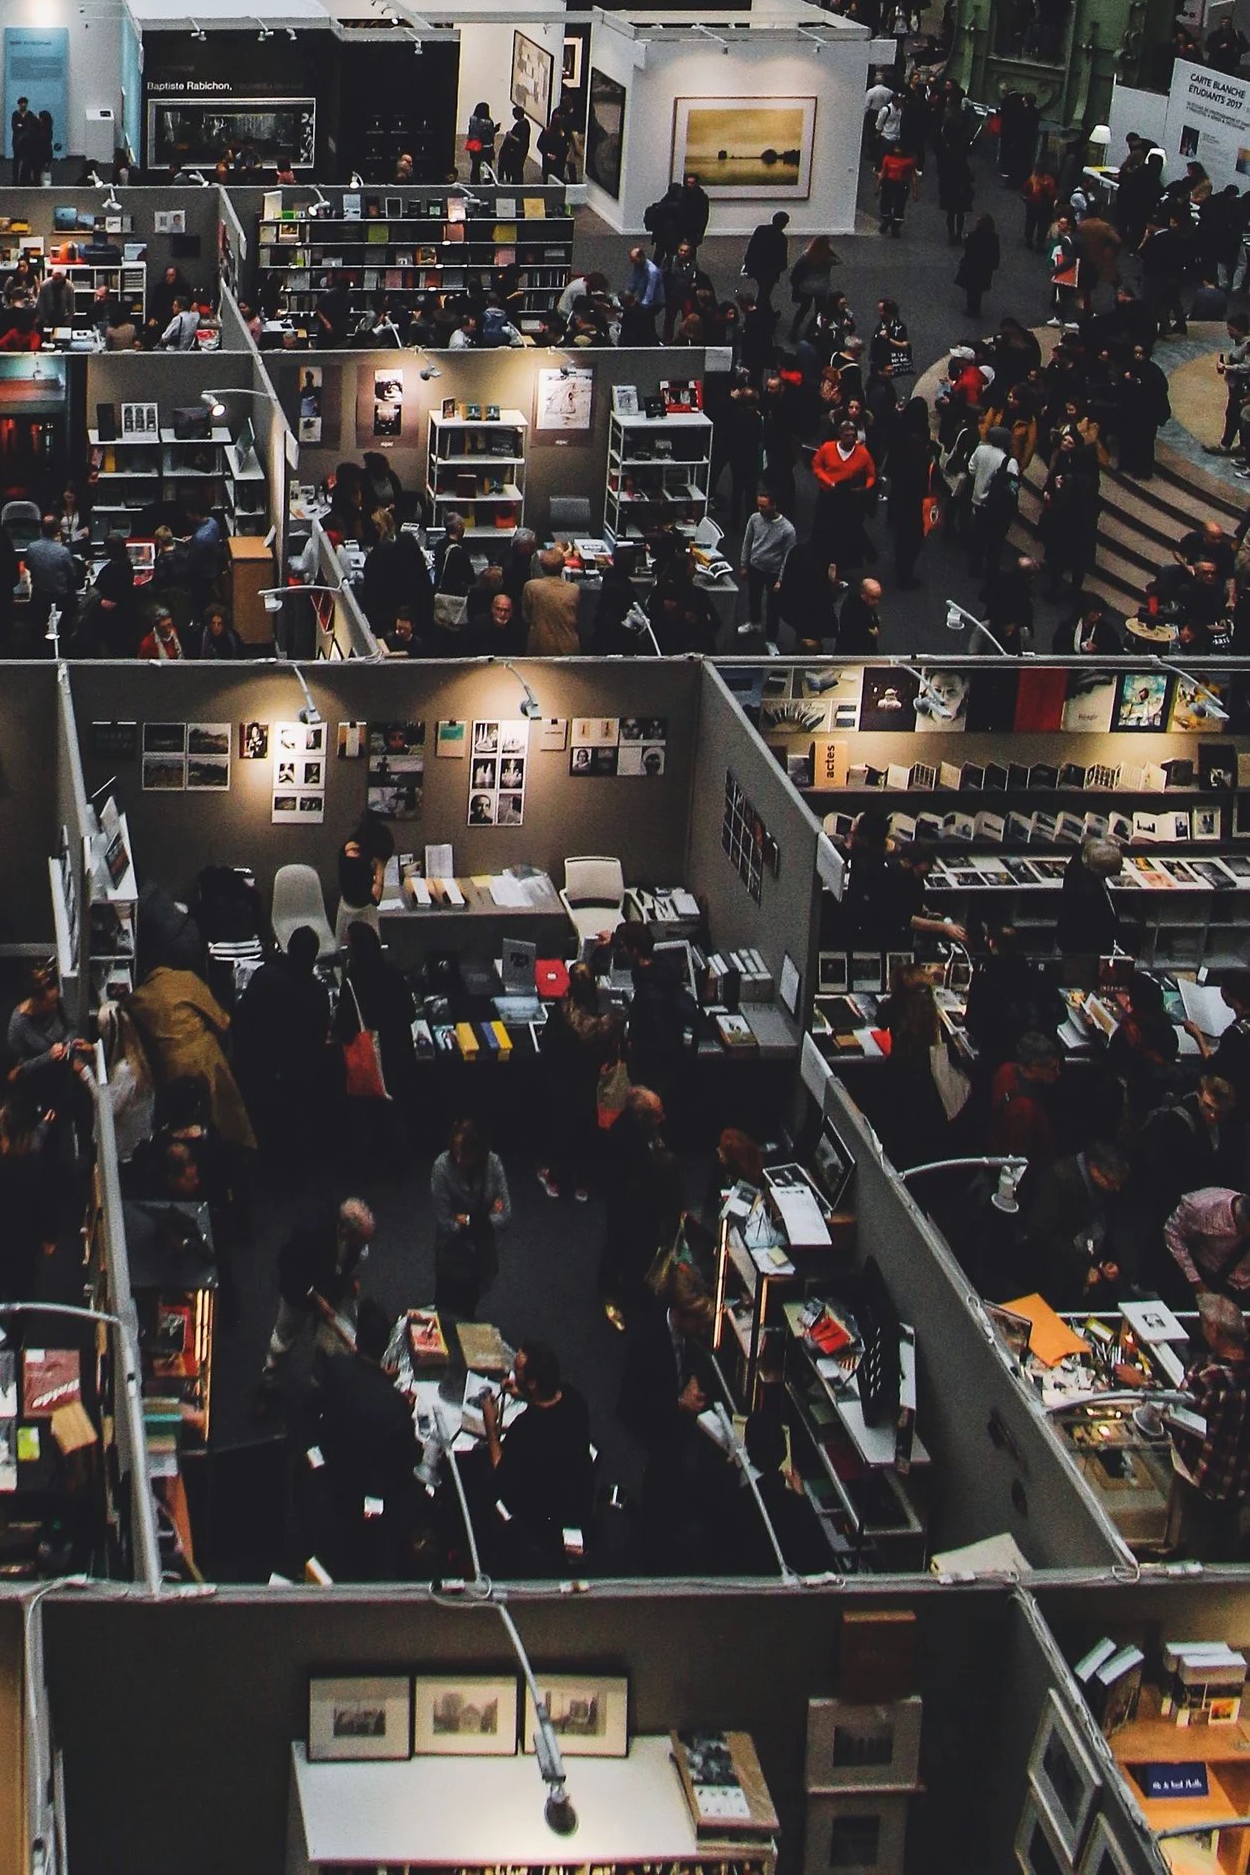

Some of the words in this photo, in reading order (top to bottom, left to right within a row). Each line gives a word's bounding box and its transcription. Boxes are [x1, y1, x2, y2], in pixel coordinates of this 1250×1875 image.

[147, 81, 185, 93] Baptiste
[186, 81, 233, 92] Rabichon,
[1190, 73, 1213, 88] CARTE
[1213, 81, 1247, 100] BLANCHE
[1226, 98, 1244, 110] 2017
[825, 745, 836, 779] actes
